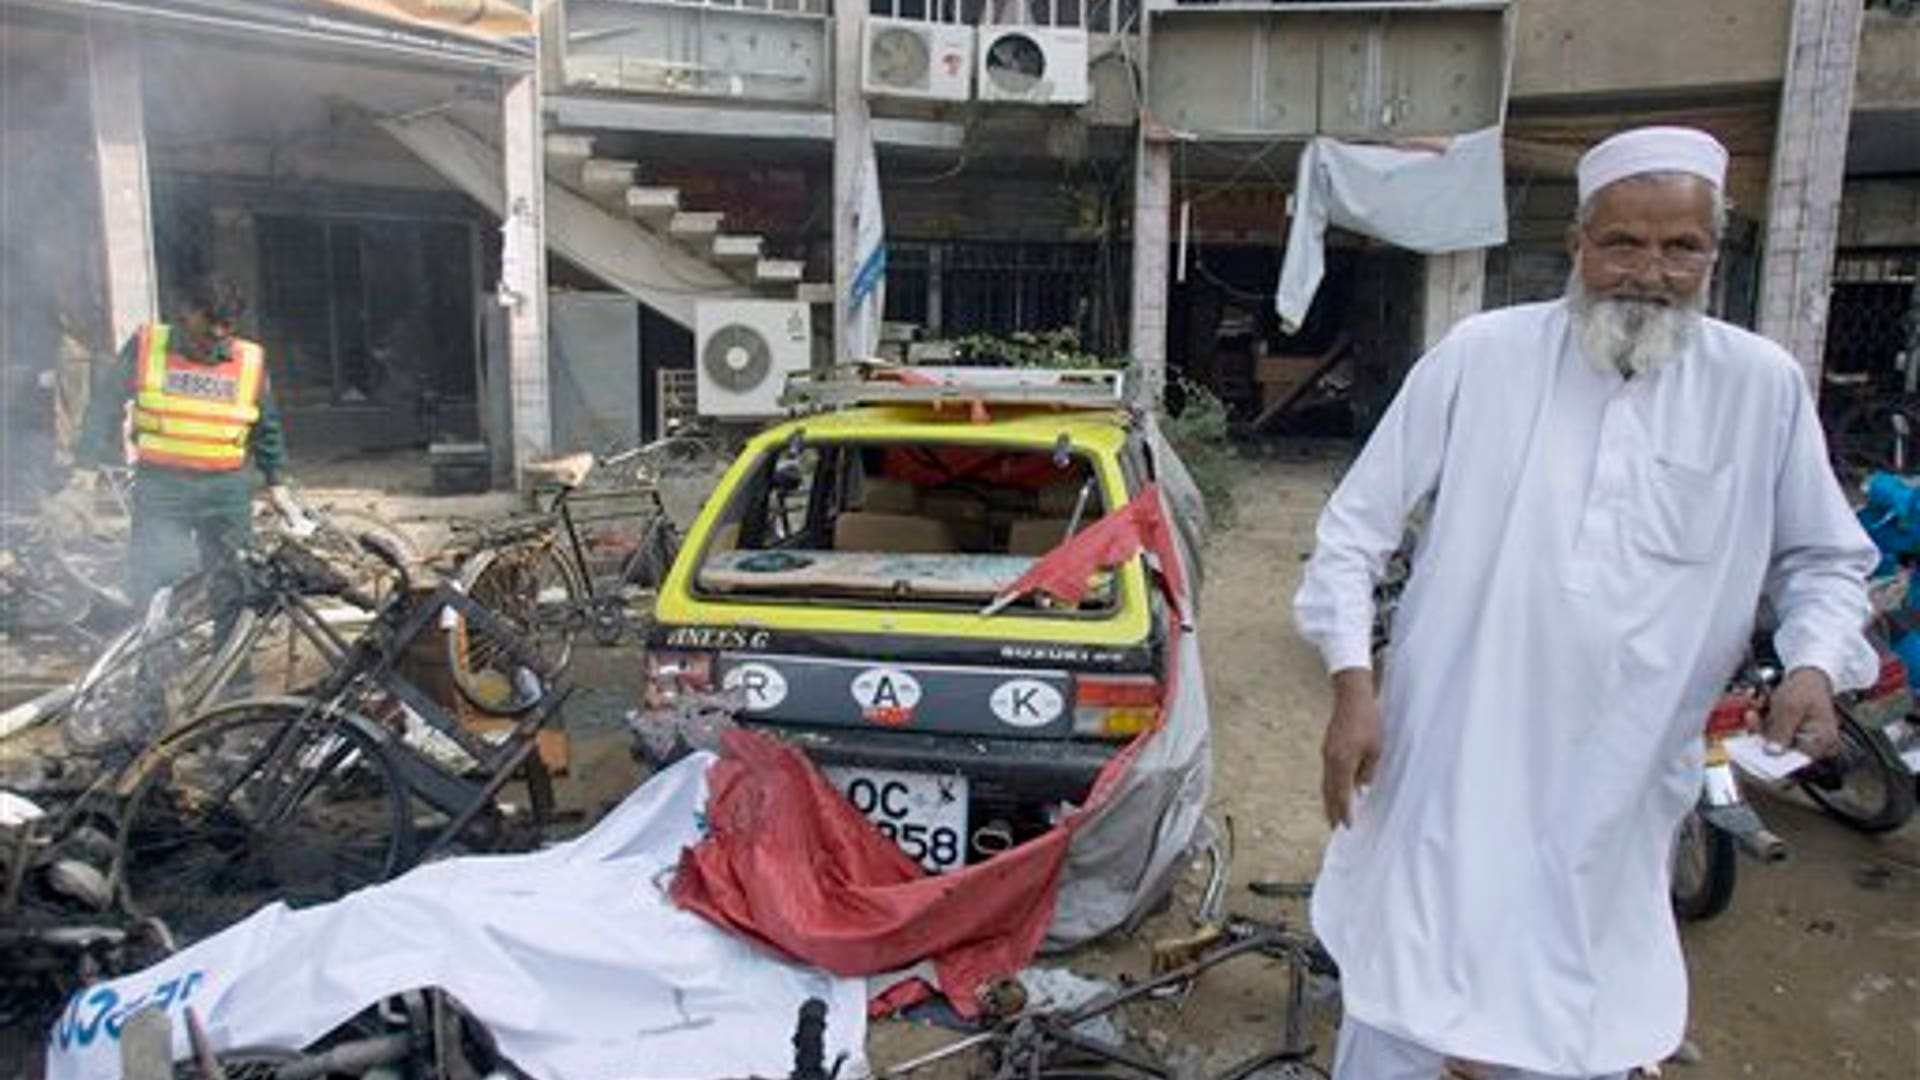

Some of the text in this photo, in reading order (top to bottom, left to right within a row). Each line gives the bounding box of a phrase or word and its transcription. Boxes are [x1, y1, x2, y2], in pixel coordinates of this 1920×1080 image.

[742, 670, 1039, 717] R A K
